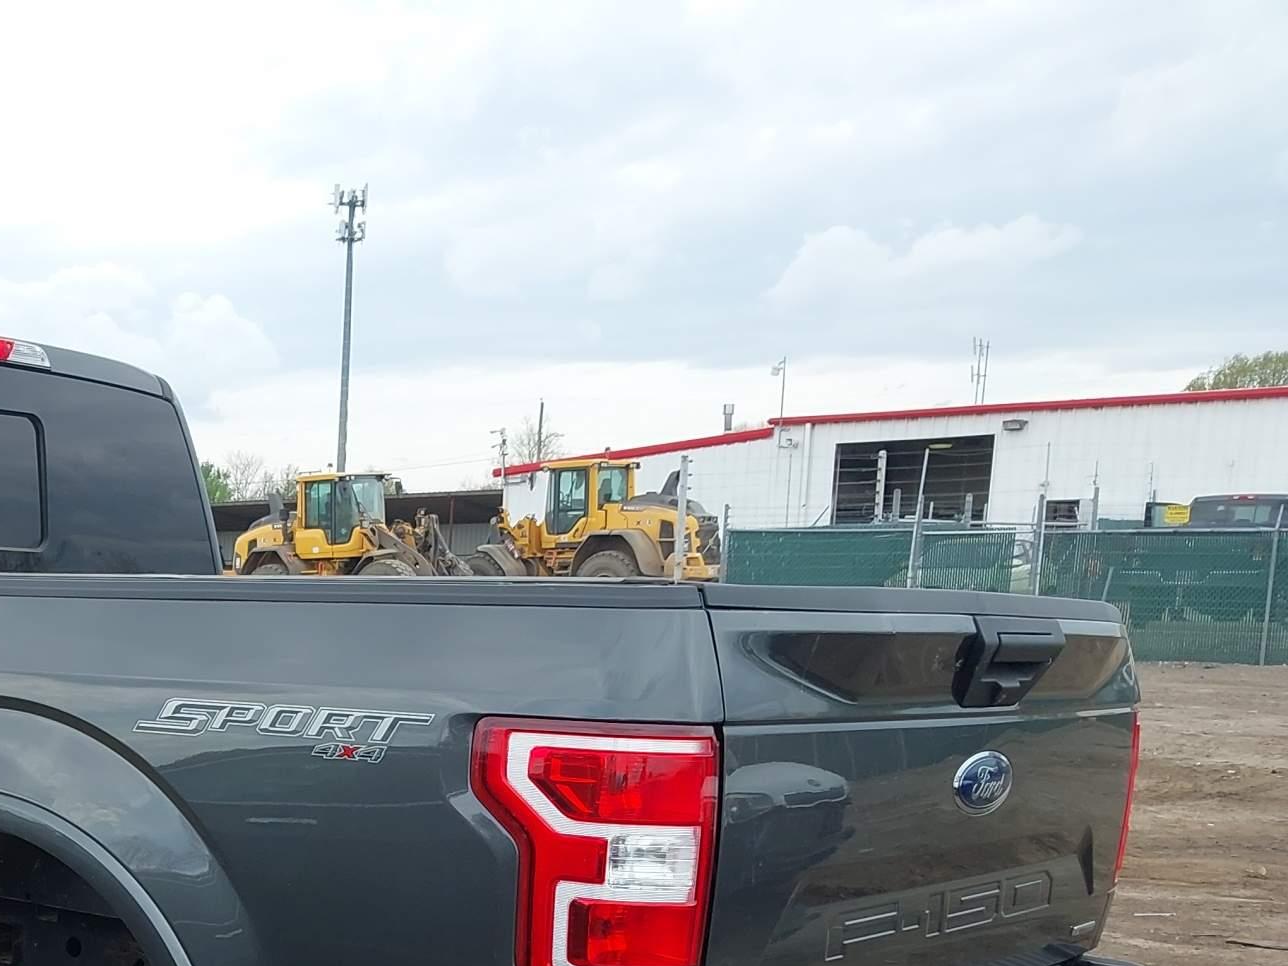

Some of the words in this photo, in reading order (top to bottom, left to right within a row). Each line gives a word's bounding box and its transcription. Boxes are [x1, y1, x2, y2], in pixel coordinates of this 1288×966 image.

[132, 696, 435, 744] SPORT
[971, 765, 1006, 800] Ford
[824, 870, 1054, 962] F-150
